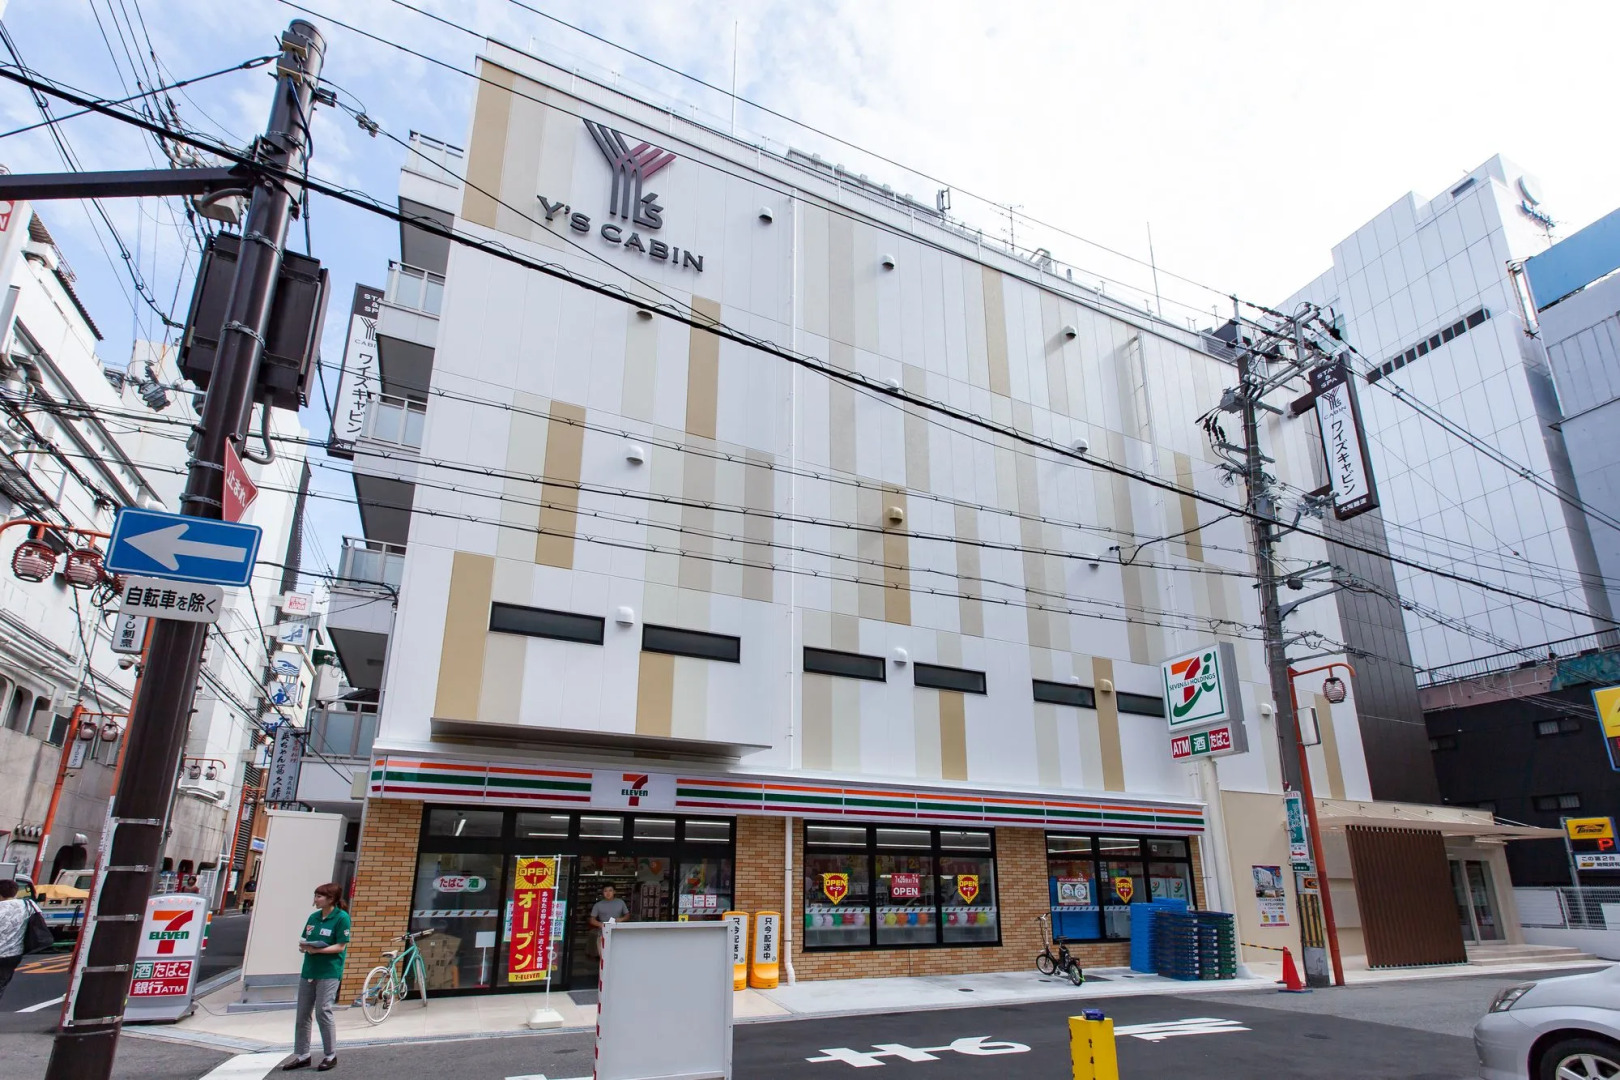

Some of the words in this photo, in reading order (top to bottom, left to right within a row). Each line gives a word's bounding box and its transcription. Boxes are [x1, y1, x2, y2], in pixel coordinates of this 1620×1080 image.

[600, 223, 704, 273] CABIN
[1316, 364, 1338, 380] STAY
[1320, 377, 1338, 389] SPA
[346, 353, 373, 434] ワイズキャビン
[1323, 405, 1347, 420] CABIN
[1331, 420, 1356, 496] ワイズキャビン
[226, 470, 246, 508] 止まれ
[125, 586, 217, 614] 自転車を除く
[1173, 741, 1190, 756] ATM
[1193, 736, 1207, 752] 酒
[1210, 731, 1230, 748] たばこ
[1598, 838, 1614, 852] P
[519, 867, 552, 876] OPEN
[440, 878, 465, 888] たばこ
[826, 879, 847, 887] OPEN
[893, 887, 919, 896] OPEN
[514, 891, 537, 971] オープン
[763, 917, 772, 961] 只今配送中
[134, 963, 153, 979] 酒
[153, 962, 190, 978] たばこ
